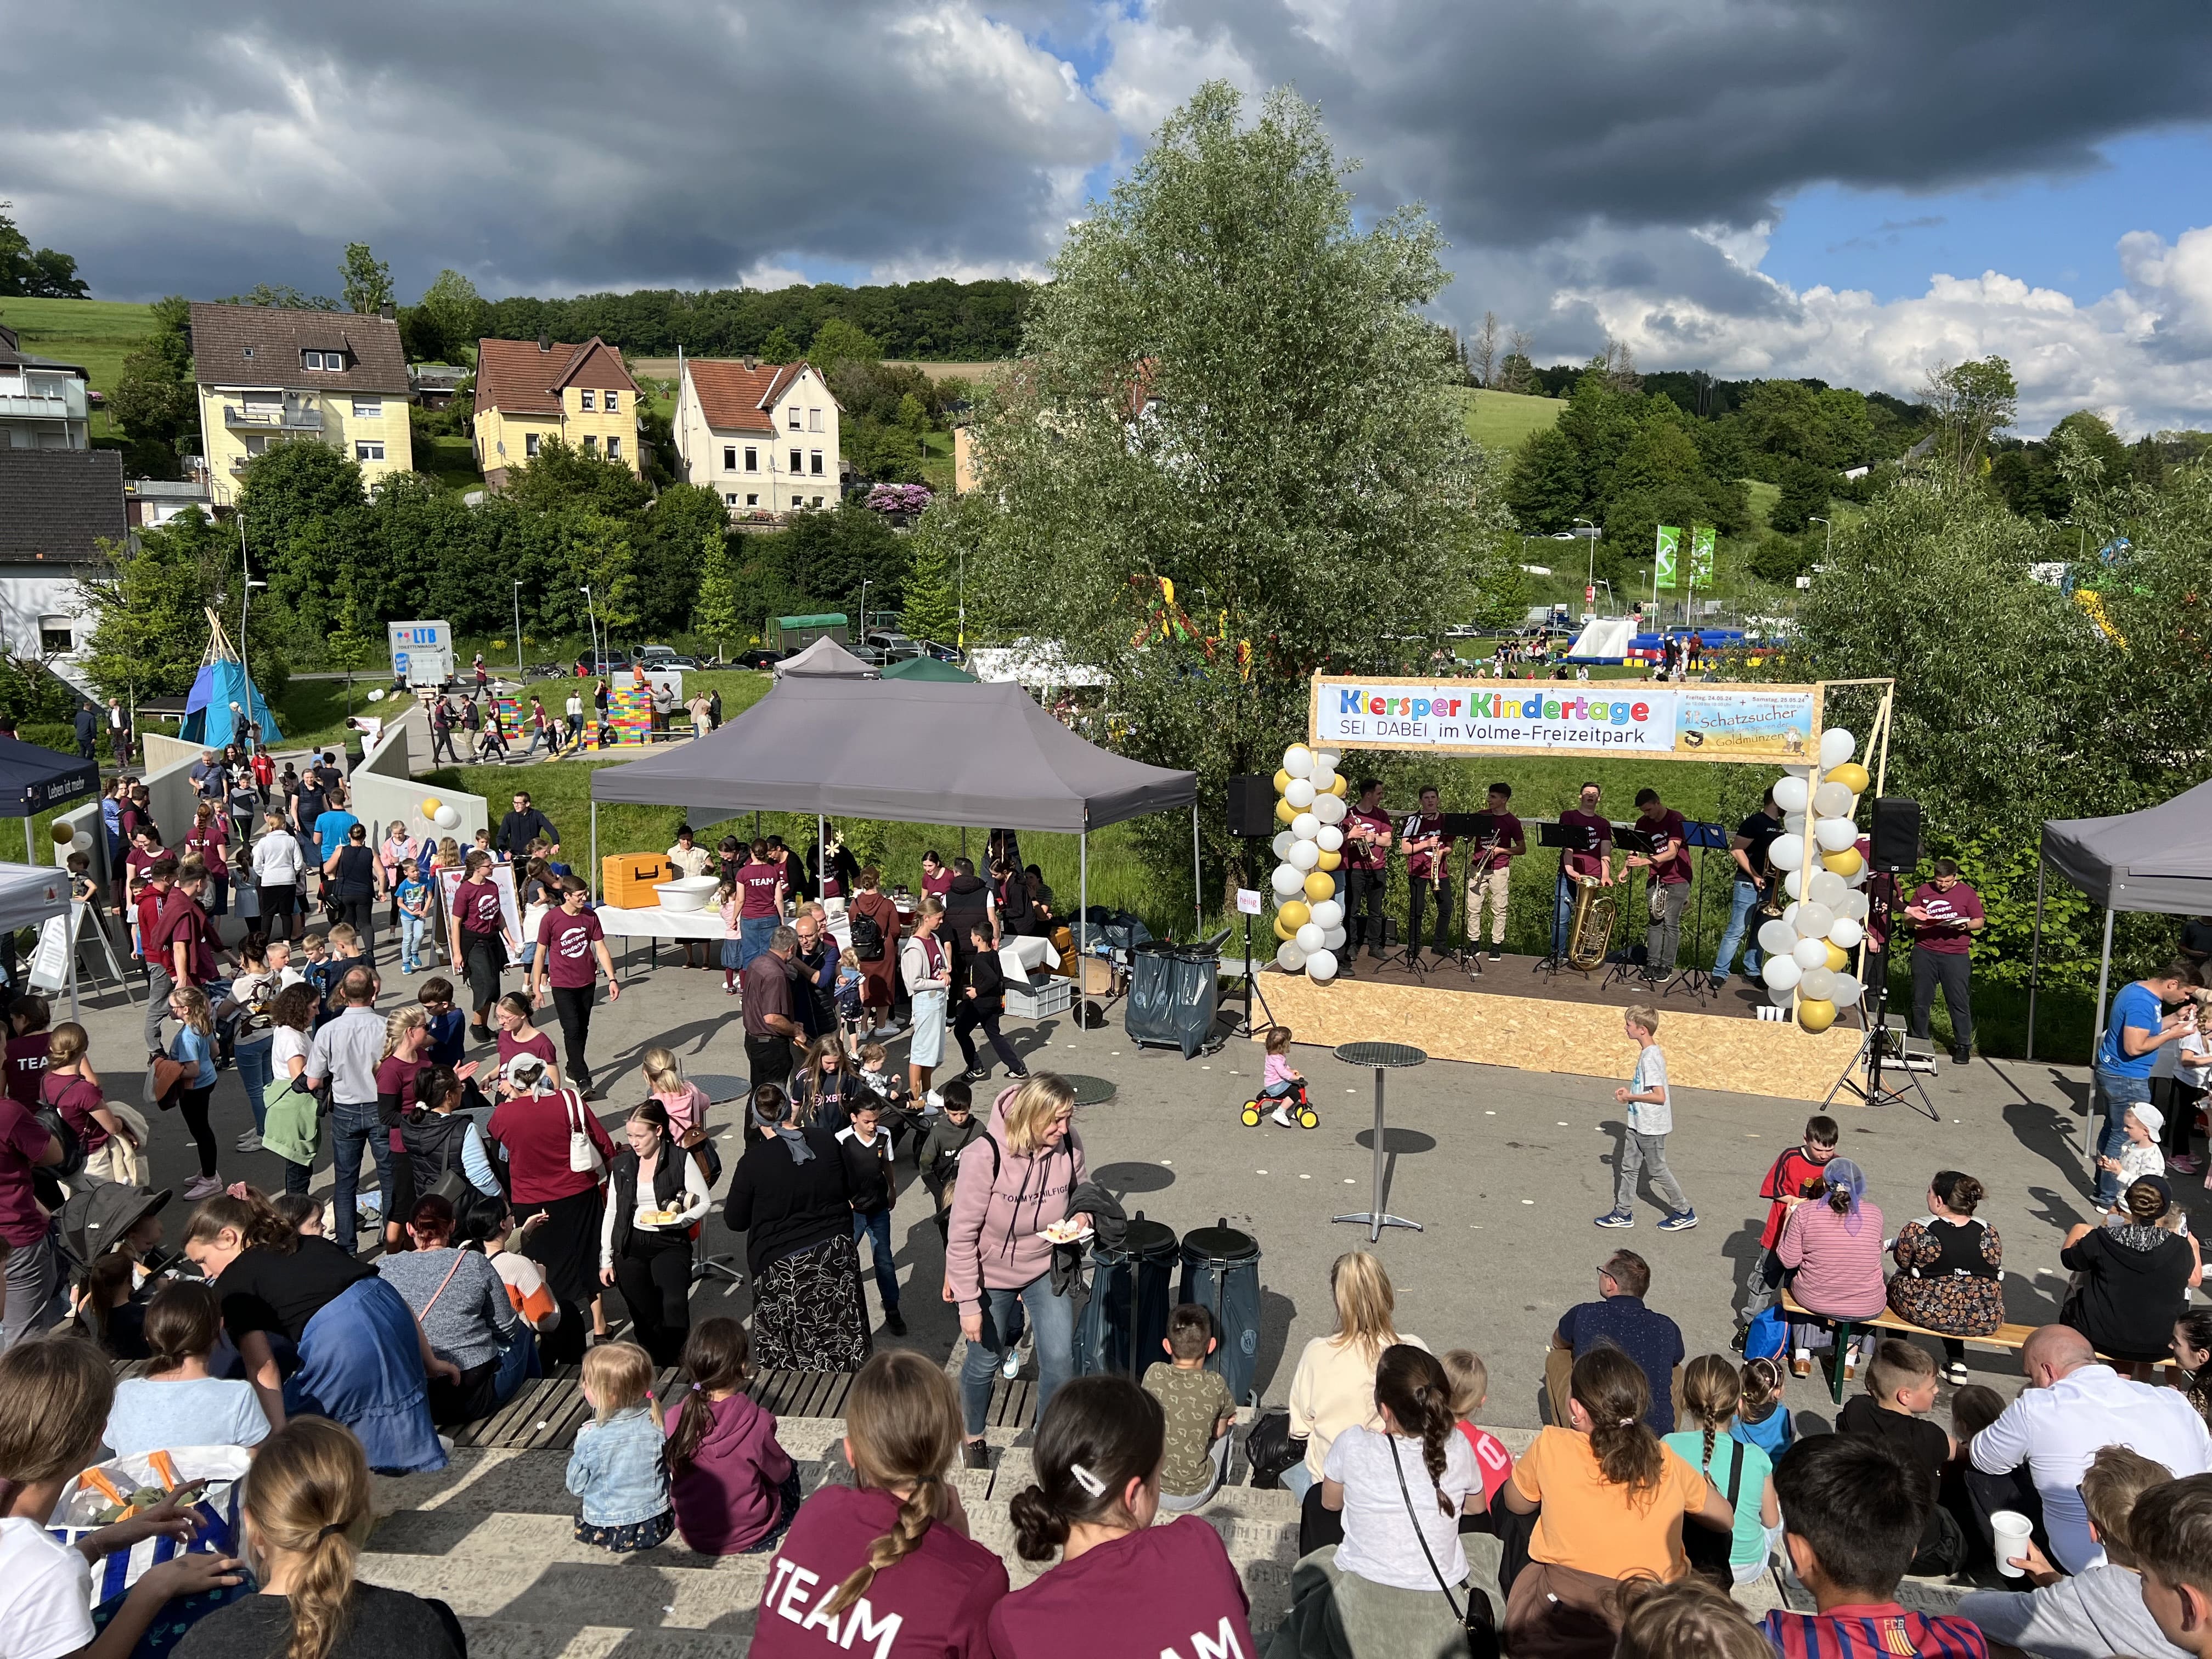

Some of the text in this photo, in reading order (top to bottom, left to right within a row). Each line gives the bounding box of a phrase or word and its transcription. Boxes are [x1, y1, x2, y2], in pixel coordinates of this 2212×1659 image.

[413, 629, 436, 644] LTB
[1340, 690, 1649, 725] Kiersper Kindertage
[1700, 706, 1797, 729] Schatzsucher
[1340, 720, 1645, 746] SEI DABEI im Volme-Freizeitpark
[1751, 724, 1776, 733] Spuren
[1716, 733, 1784, 747] Goldmünzen
[47, 775, 85, 800] Leben ist mehr
[749, 877, 774, 887] TEAM
[1240, 896, 1257, 908] heilig
[560, 933, 585, 947] Kiersper
[17, 1056, 49, 1071] TEA
[765, 1557, 904, 1659] TEAM
[1883, 1619, 1904, 1629] FCB
